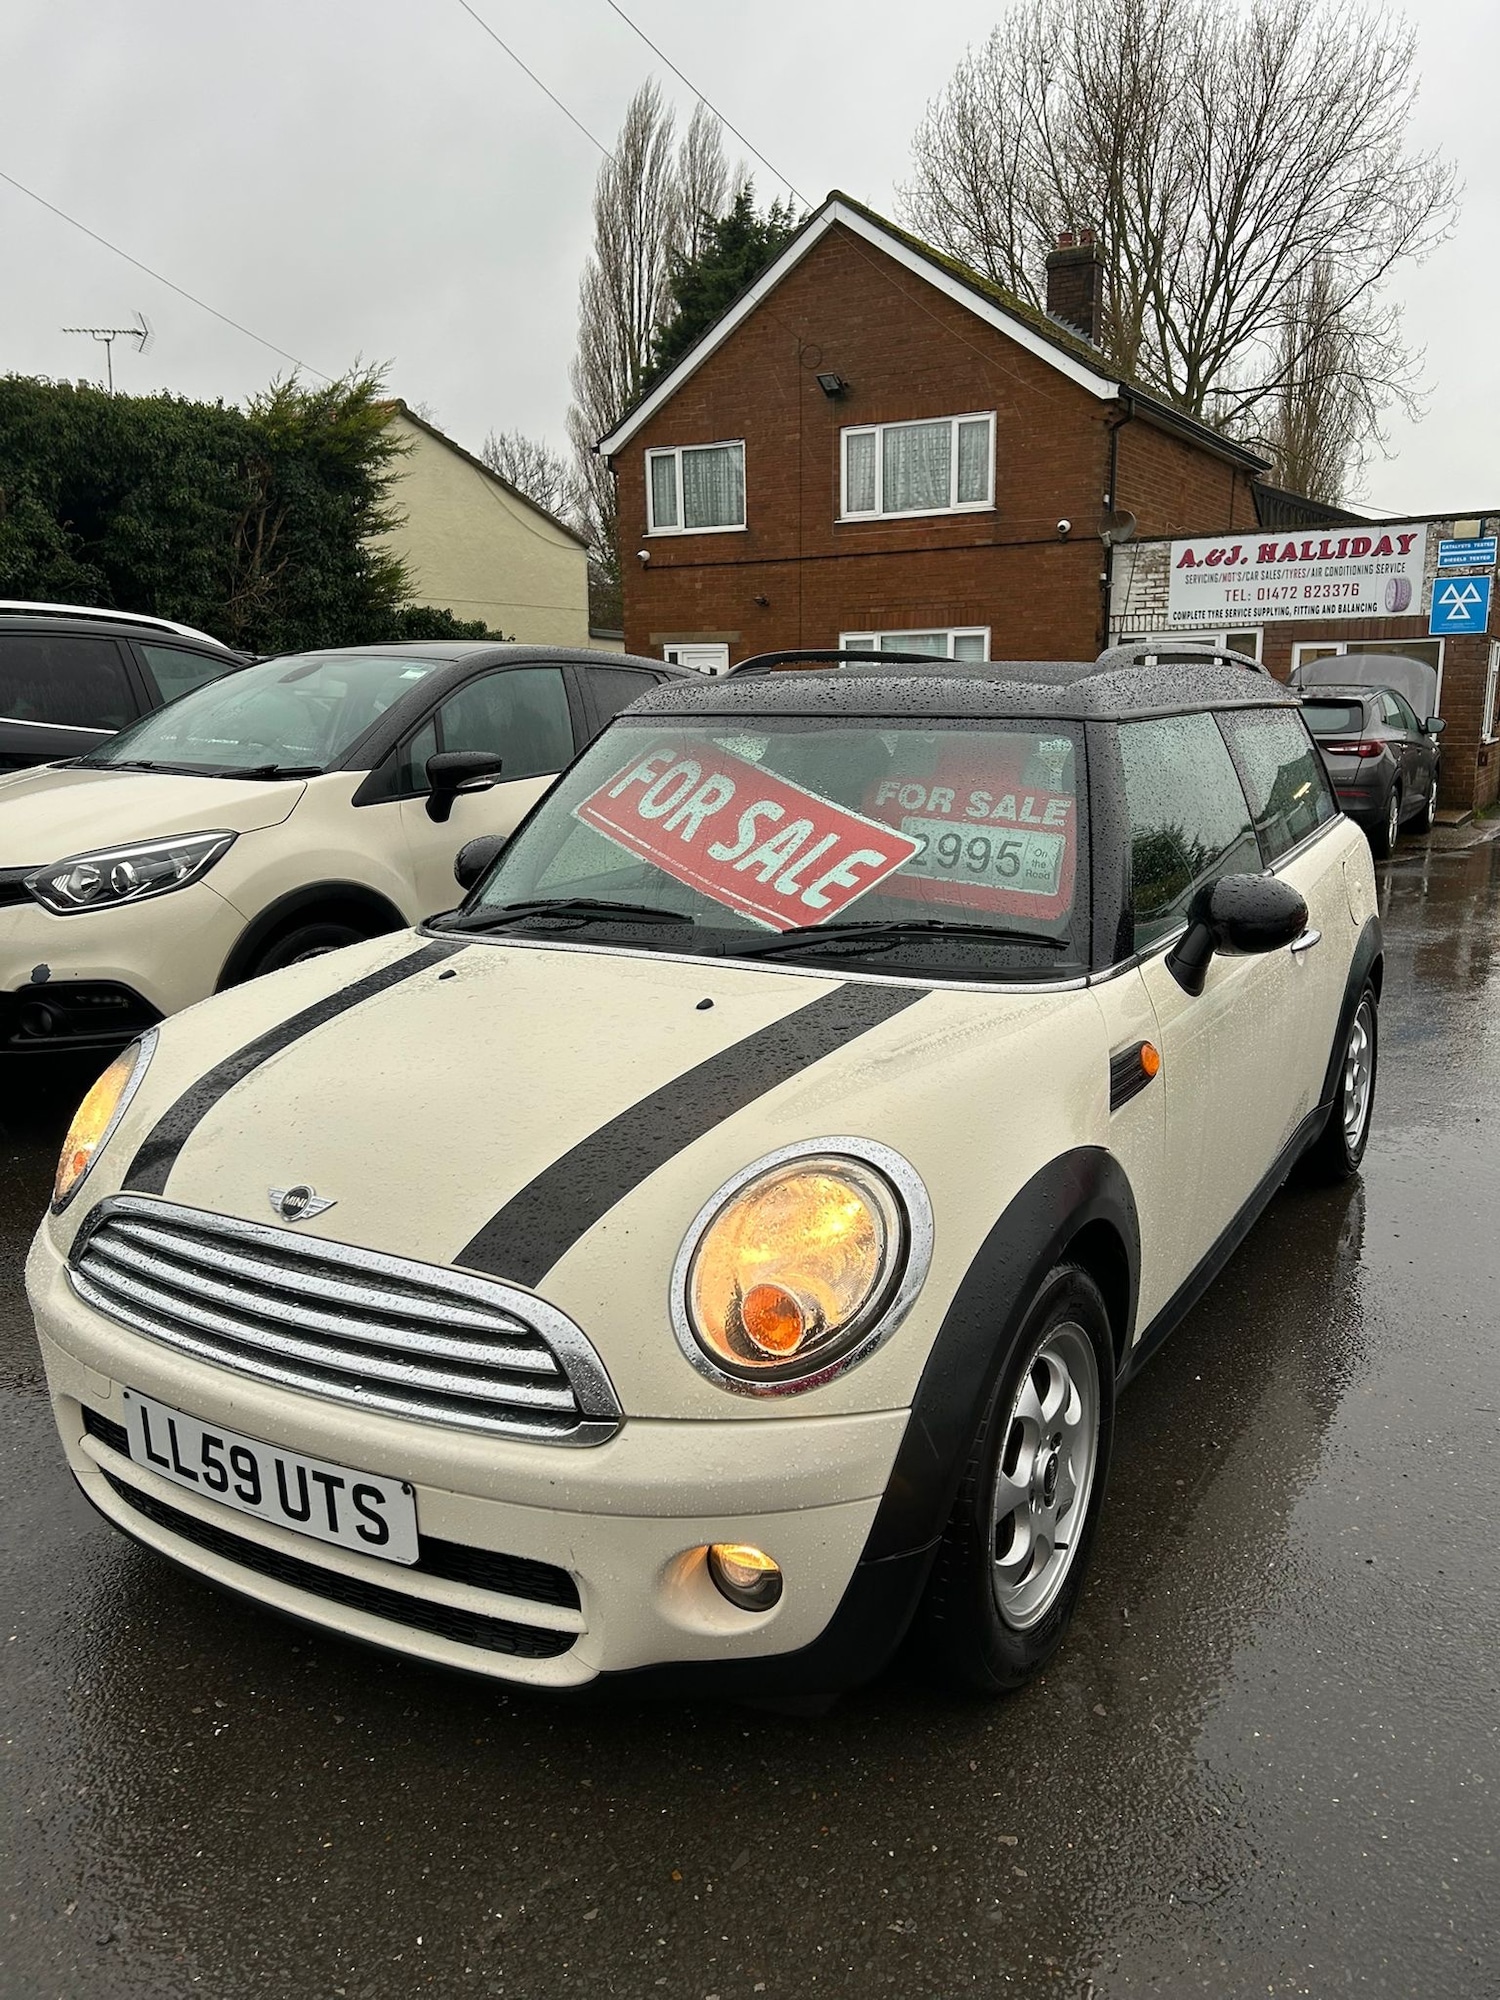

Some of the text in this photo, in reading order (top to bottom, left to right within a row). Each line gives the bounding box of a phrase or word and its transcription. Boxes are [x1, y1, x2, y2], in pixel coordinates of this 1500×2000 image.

[1256, 533, 1418, 564] HALLIDAY
[1261, 567, 1322, 581] SALES/TYRES/AIR
[1324, 564, 1374, 577] CONDITIONING
[1375, 562, 1406, 574] SERVICE
[1225, 583, 1360, 602] TEL: 01472 823376
[1173, 602, 1378, 620] COMPLETE TYRE SERVICE SUPPLYING, FITTING AND BALANCING
[875, 780, 1072, 827] FOR SALE
[608, 749, 736, 843] FOR
[707, 800, 888, 909] SALE
[1033, 847, 1048, 858] On
[1031, 859, 1047, 869] the
[1025, 869, 1050, 880] Road
[284, 1195, 308, 1208] MINI
[141, 1405, 389, 1546] LL59 UTS
